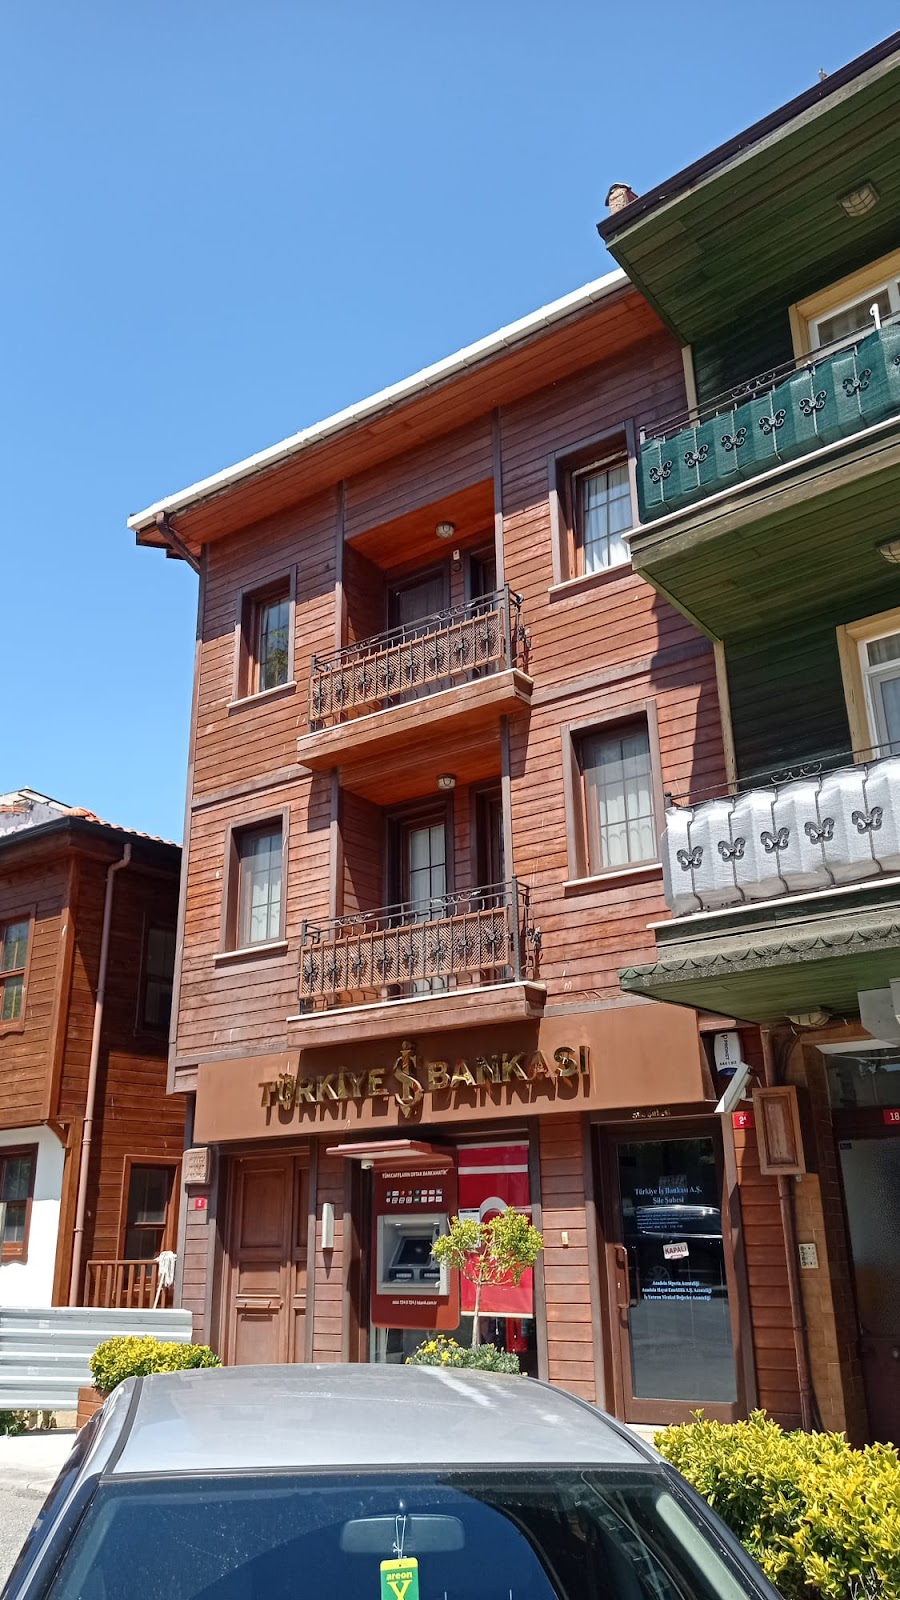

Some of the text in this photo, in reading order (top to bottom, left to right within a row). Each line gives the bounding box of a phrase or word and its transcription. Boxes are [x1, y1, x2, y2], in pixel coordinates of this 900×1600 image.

[258, 1066, 389, 1111] TÜRKİYE
[427, 1045, 590, 1090] BANKASI
[634, 1188, 658, 1196] Türkiye
[665, 1196, 684, 1204] Şubesi
[665, 1246, 687, 1254] KAPALI
[386, 1571, 413, 1581] areon
